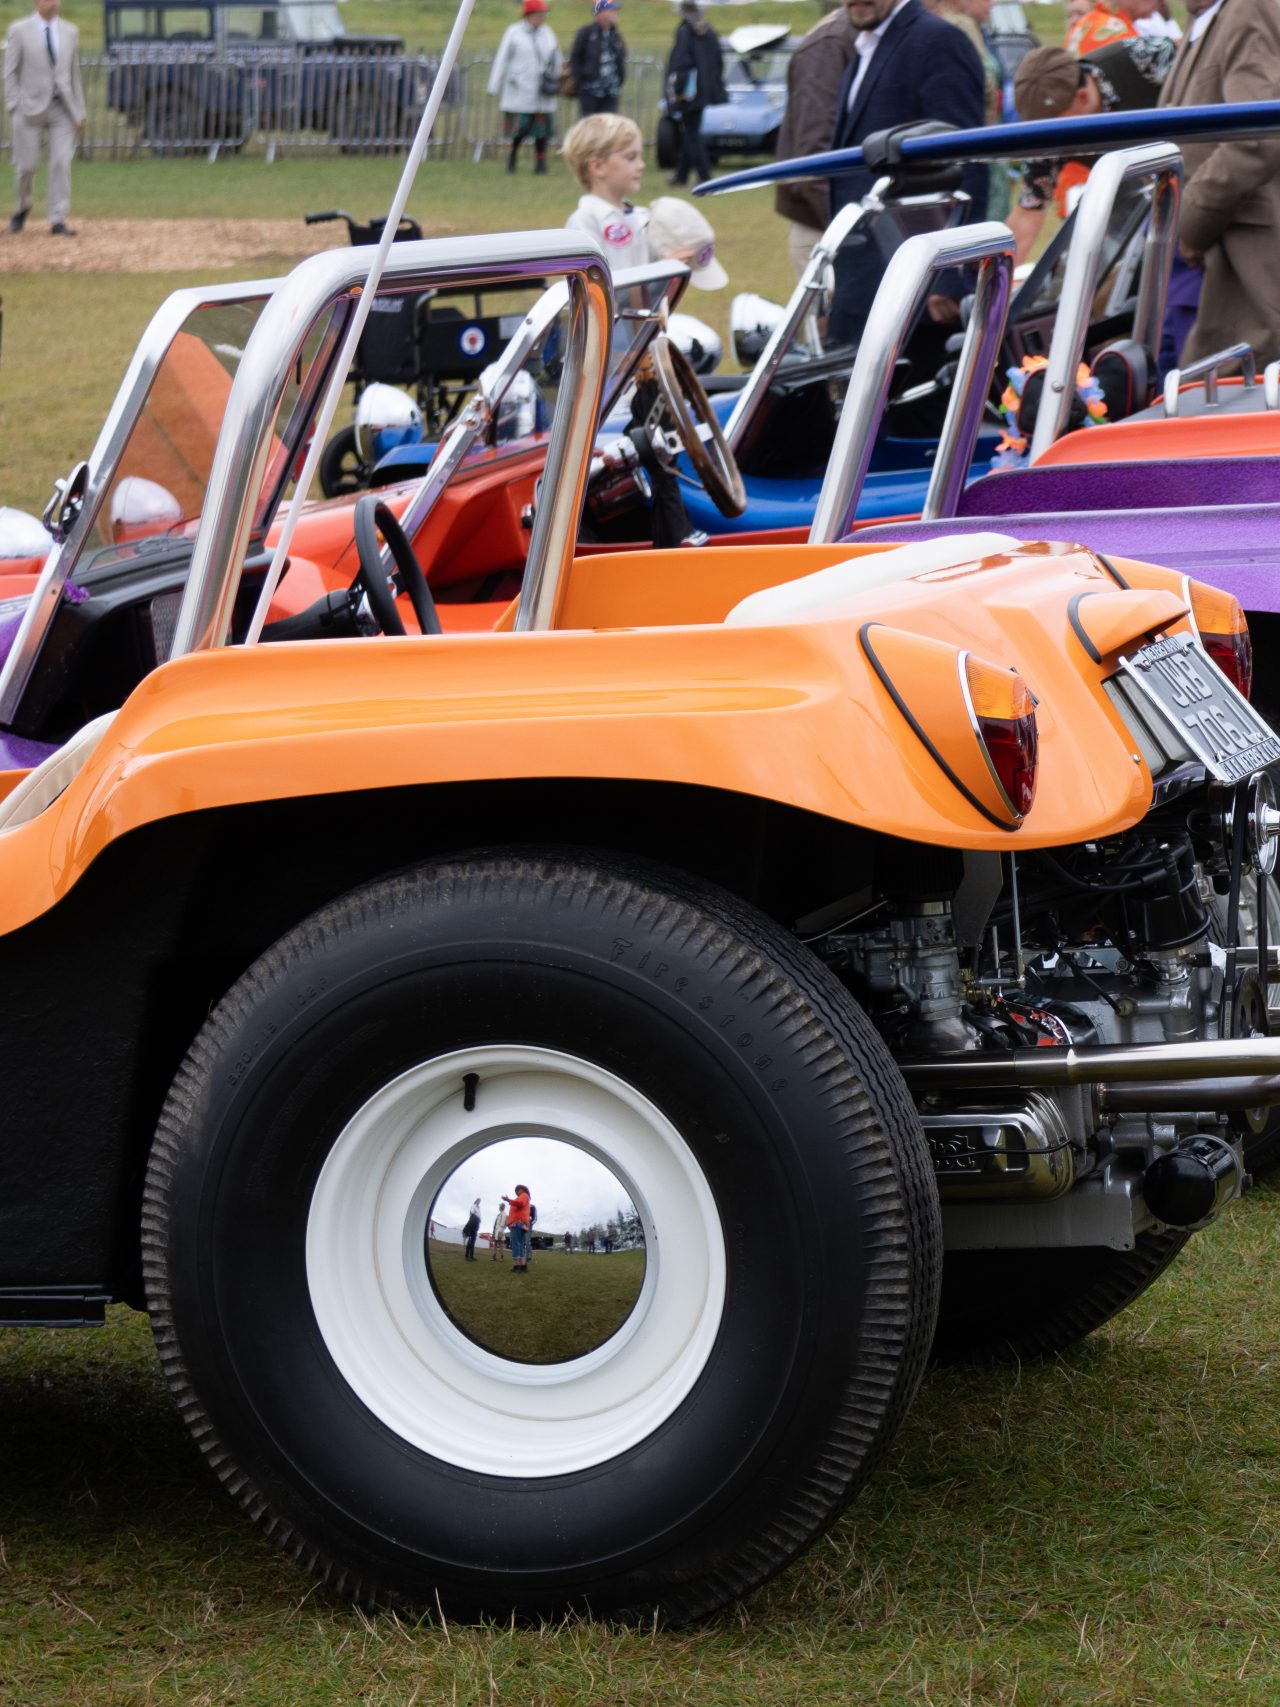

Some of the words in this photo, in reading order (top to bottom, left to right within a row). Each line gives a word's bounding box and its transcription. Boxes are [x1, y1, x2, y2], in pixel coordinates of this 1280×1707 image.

[1155, 653, 1213, 707] JWB
[1183, 699, 1263, 755] 706J
[610, 936, 790, 1094] Firestone
